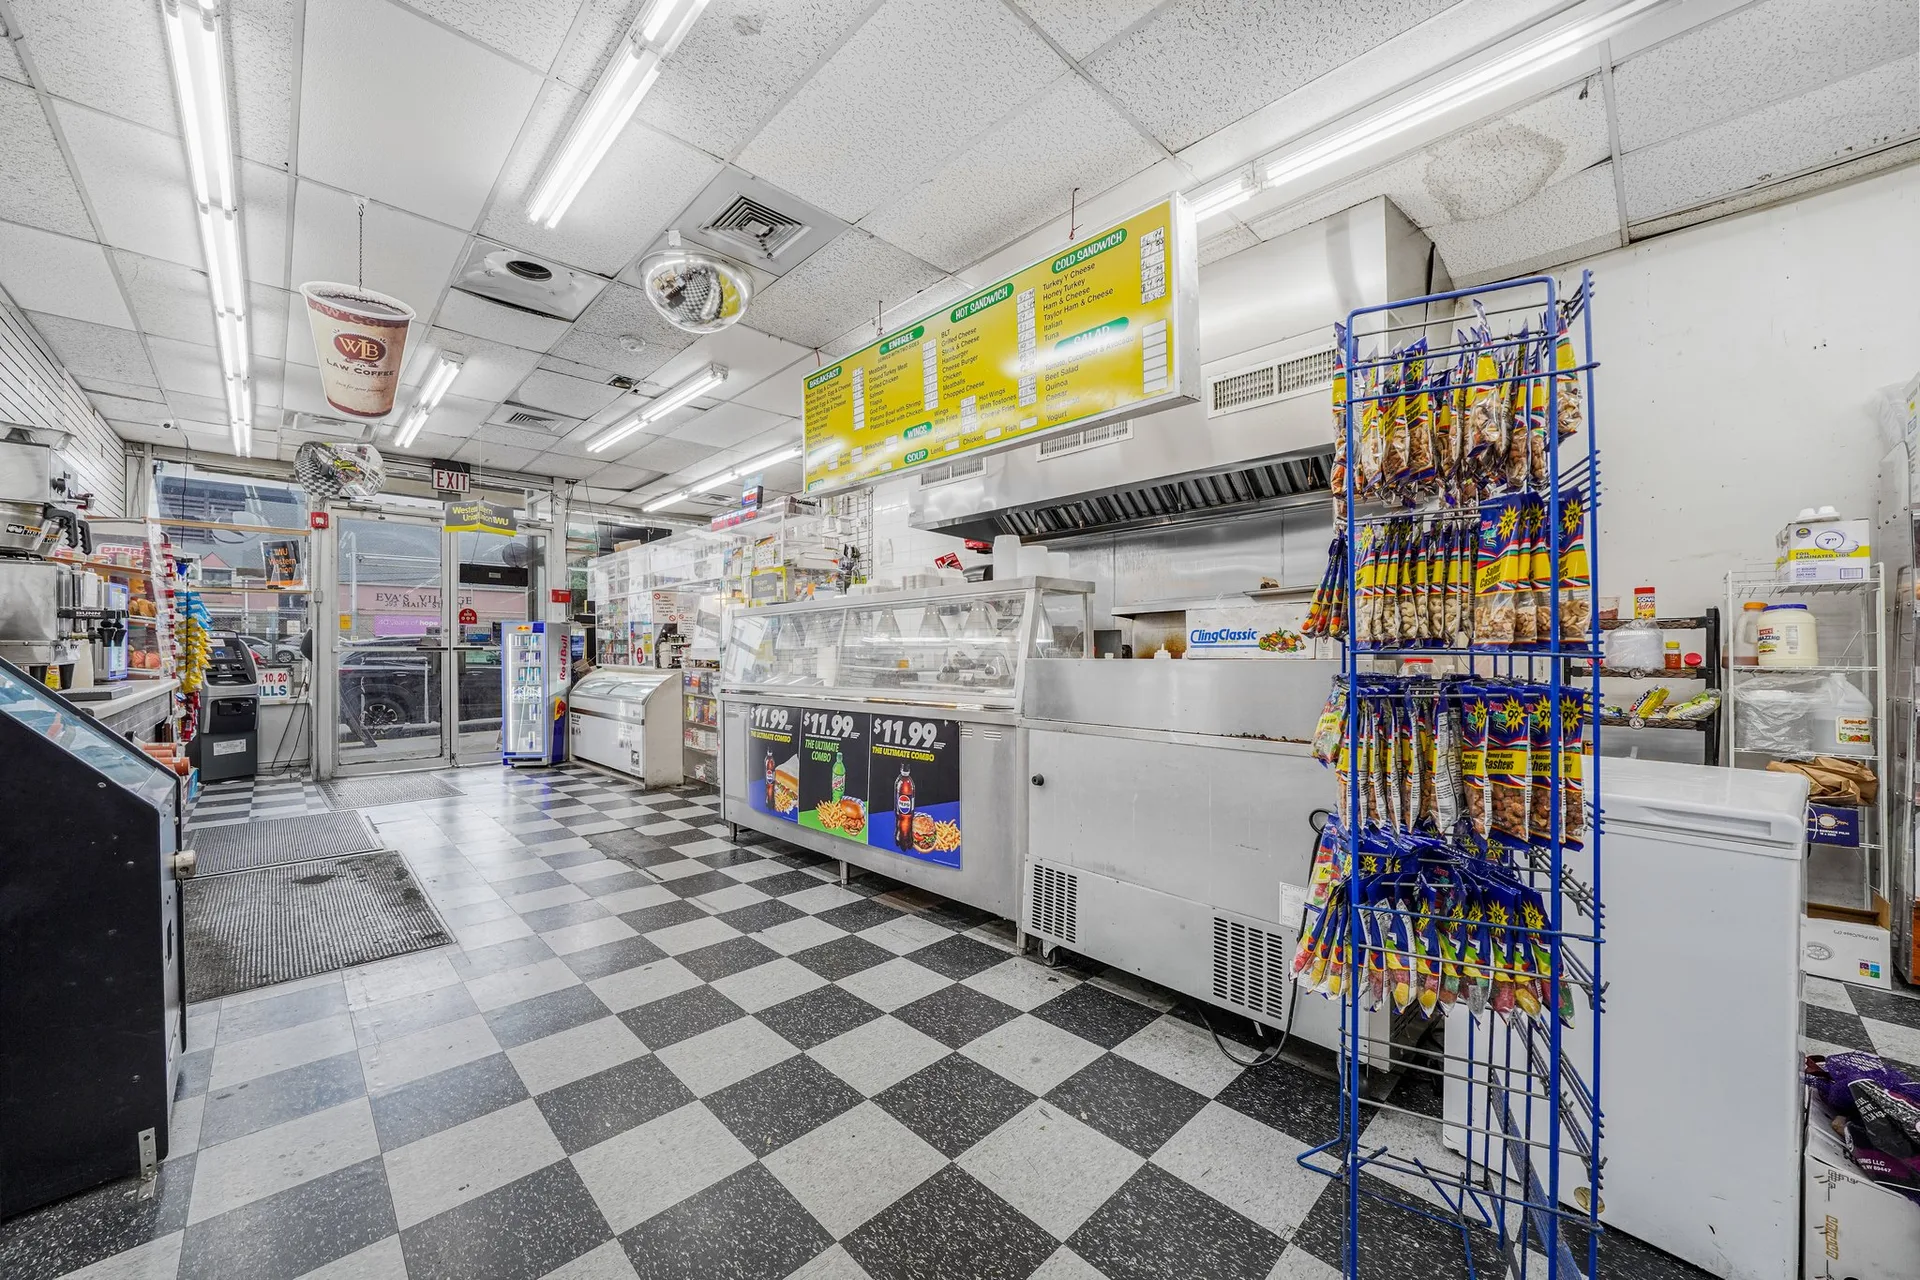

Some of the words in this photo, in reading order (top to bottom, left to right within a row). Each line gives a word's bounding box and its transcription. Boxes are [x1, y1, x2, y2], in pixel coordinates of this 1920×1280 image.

[1055, 254, 1076, 271] COLD
[1077, 231, 1123, 261] SANDWICH
[1043, 276, 1063, 291] Turkey
[1070, 262, 1095, 278] Cheese
[1043, 288, 1062, 301] Honey
[1064, 279, 1086, 292] Turkey
[955, 306, 969, 320] HOT
[970, 286, 1008, 313] SANDWICH
[1043, 301, 1058, 311] Ham
[1065, 287, 1090, 302] Cheese
[1043, 307, 1062, 321] Taylor
[1064, 302, 1079, 313] Ham
[1087, 288, 1114, 304] Cheese
[1043, 320, 1063, 331] Italian
[888, 331, 914, 350] ENTREE
[941, 329, 950, 338] BLT
[941, 336, 957, 347] Grilled
[958, 328, 977, 340] Cheese
[1044, 332, 1059, 342] Tuna
[960, 336, 980, 348] Cheese
[1068, 348, 1098, 363] Cucumber
[1106, 336, 1134, 350] Avocado
[942, 350, 968, 364] Hamburger
[326, 358, 349, 372] LAW
[354, 367, 394, 377] COFFEE
[942, 363, 960, 374] Cheese
[961, 355, 978, 366] Burger
[810, 368, 840, 389] BREAKFAST
[942, 371, 962, 382] Chicken
[1045, 371, 1059, 382] Beet
[1060, 365, 1079, 377] Salad
[942, 379, 966, 391] Meatballs
[943, 387, 965, 400] Chopped
[966, 381, 985, 391] Cheese
[1045, 380, 1068, 392] Quinoa
[989, 388, 1006, 398] Wings
[1045, 390, 1068, 401] Caesar
[906, 400, 921, 410] Shrimp
[980, 402, 992, 411] With
[992, 394, 1017, 406] Tostones
[906, 408, 923, 418] Chicken
[934, 408, 949, 417] Wings
[1046, 410, 1068, 422] Yogurt
[907, 425, 928, 439] WINGS
[907, 450, 926, 462] SOUP
[963, 435, 983, 445] Chicken
[1005, 425, 1017, 433] Fish
[436, 470, 468, 491] EXIT
[268, 557, 297, 566] Western
[274, 566, 294, 574] Union
[376, 592, 409, 603] EVA'S
[1190, 628, 1258, 644] ClingClassic
[560, 635, 568, 656] Bull
[559, 656, 567, 681] Red
[278, 672, 287, 683] 20
[259, 685, 287, 697] ILLS
[750, 706, 789, 730] $11.99
[803, 711, 854, 738] $11.99
[757, 732, 775, 741] ULTIMATE
[774, 734, 792, 744] COMBO
[873, 718, 938, 748] $11.99
[805, 740, 815, 749] THE
[815, 741, 840, 753] ULTIMATE
[811, 751, 832, 763] COMBO
[872, 746, 883, 755] THE
[883, 748, 911, 759] ULTIMATE
[911, 751, 936, 762] COMBO
[1486, 759, 1514, 771] Cashews
[1872, 1159, 1885, 1167] LLC
